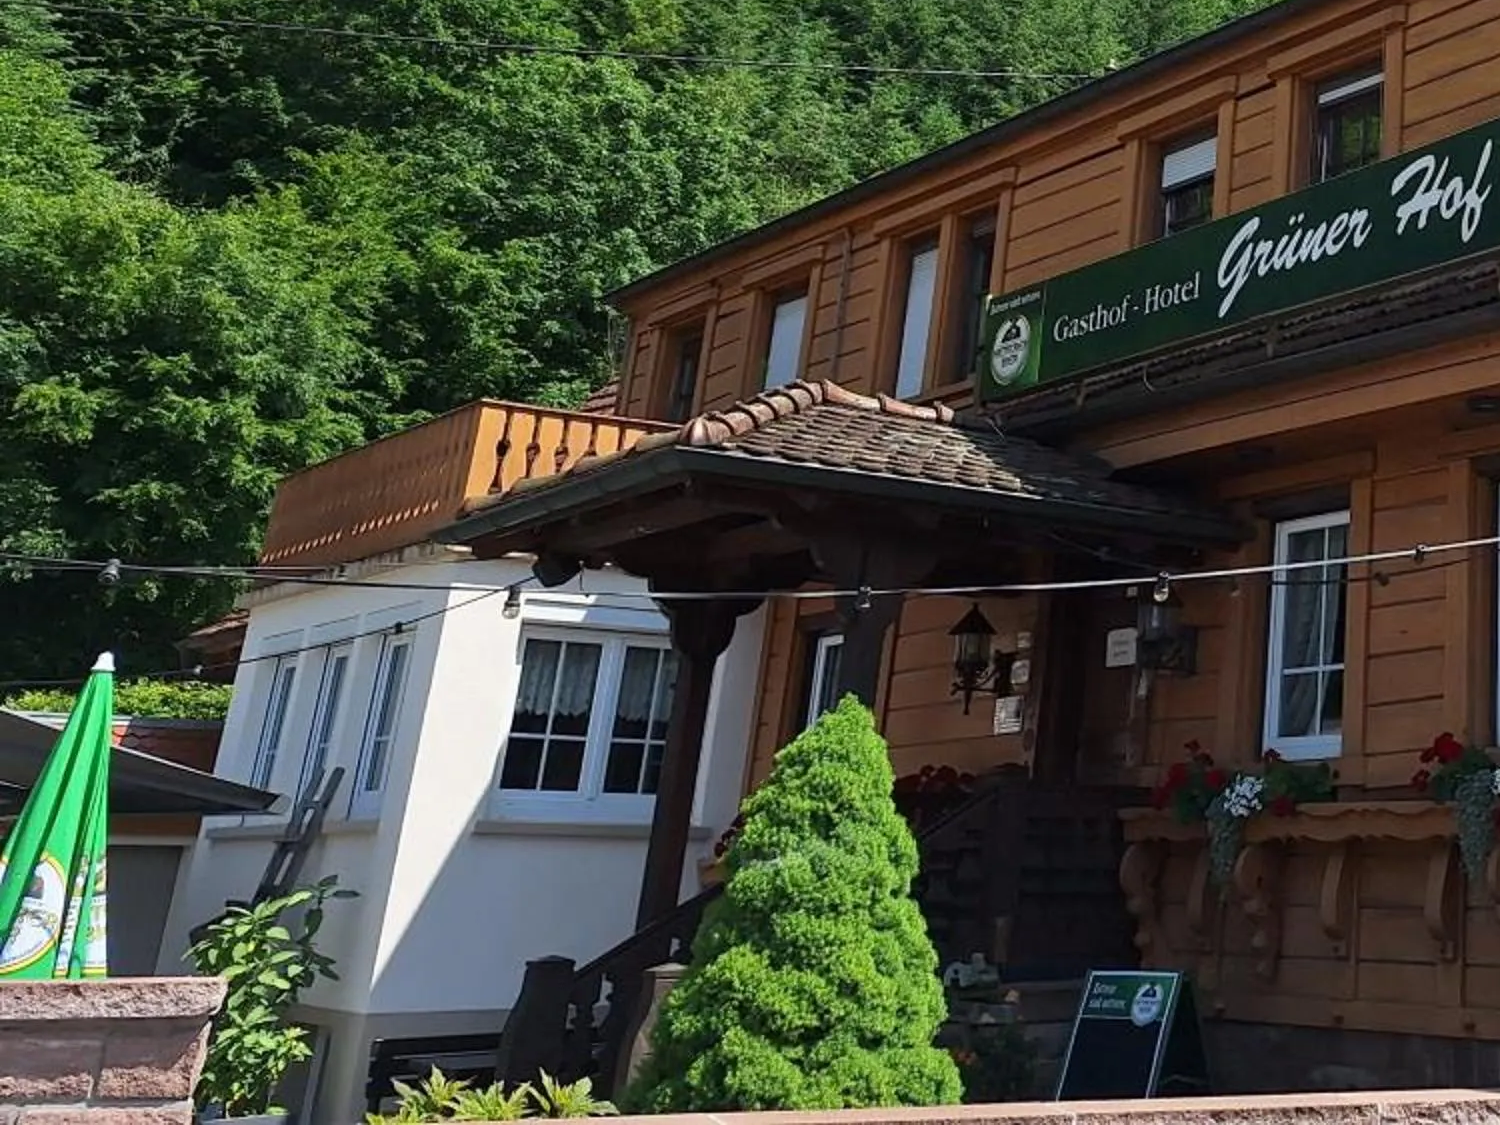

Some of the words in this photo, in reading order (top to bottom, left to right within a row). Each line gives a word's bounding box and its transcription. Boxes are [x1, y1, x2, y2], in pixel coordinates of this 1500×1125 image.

[1217, 207, 1372, 318] Grüner
[1391, 139, 1492, 243] Hof
[1053, 294, 1131, 342] Gasthof
[1144, 271, 1201, 315] Hotel
